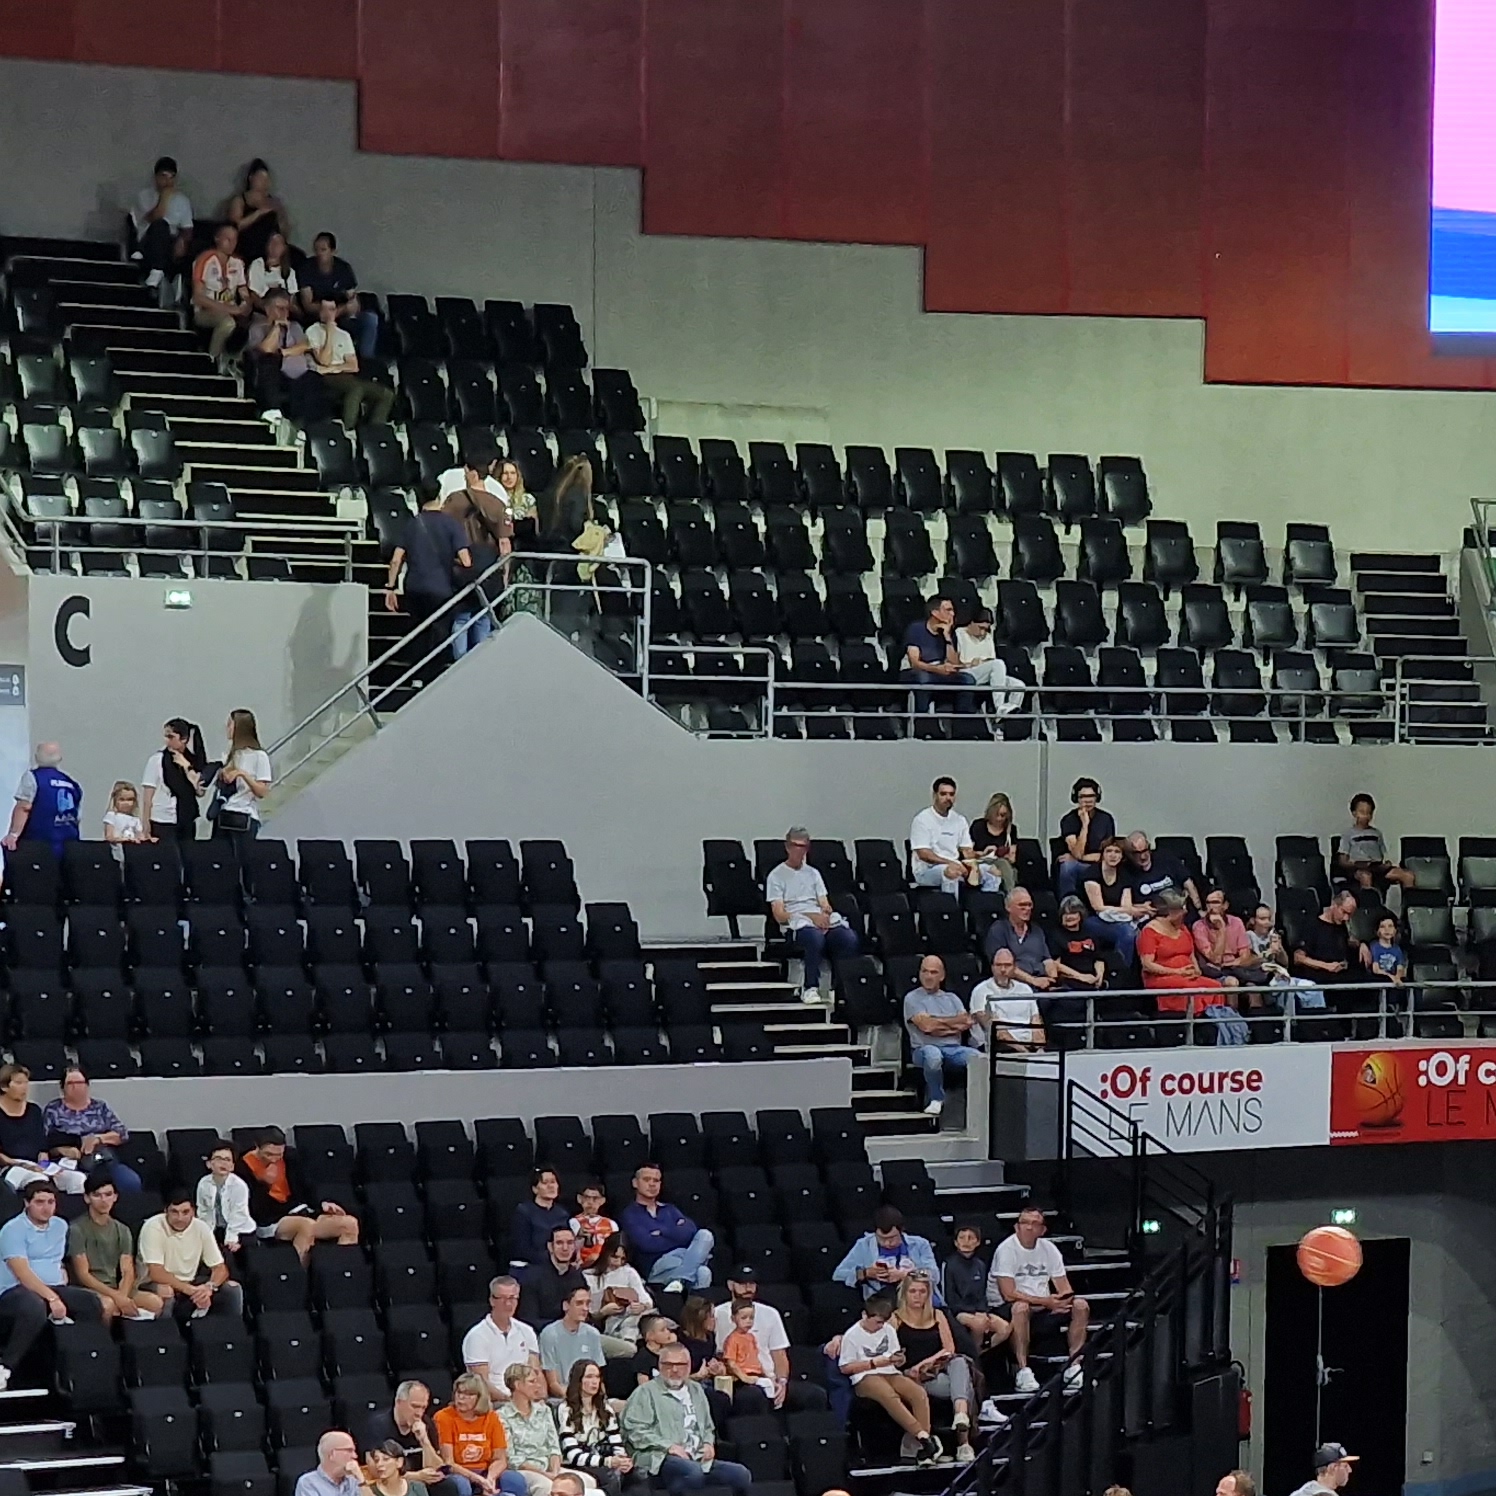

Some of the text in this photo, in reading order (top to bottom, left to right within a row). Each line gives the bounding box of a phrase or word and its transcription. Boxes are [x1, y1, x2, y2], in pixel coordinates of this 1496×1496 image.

[54, 594, 92, 668] C
[1160, 1069, 1263, 1096] course
[1166, 1098, 1263, 1138] MANS
[1426, 1090, 1466, 1126] LE
